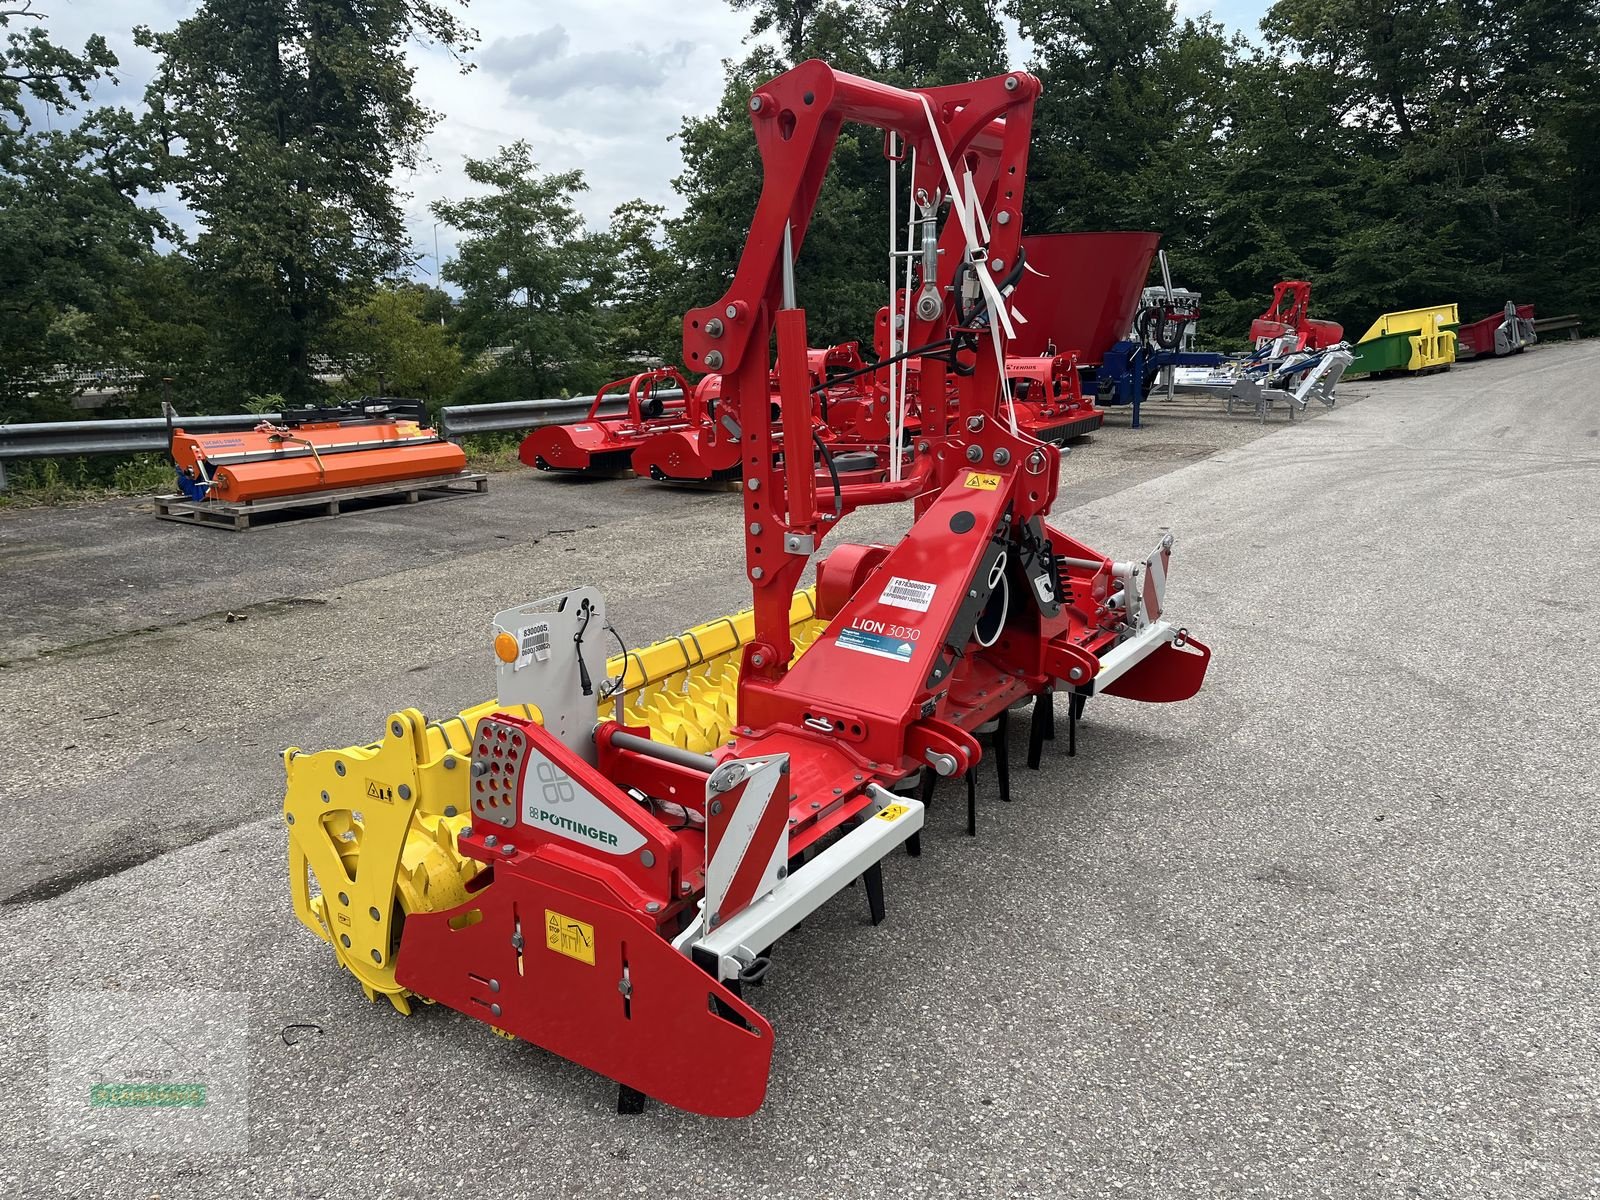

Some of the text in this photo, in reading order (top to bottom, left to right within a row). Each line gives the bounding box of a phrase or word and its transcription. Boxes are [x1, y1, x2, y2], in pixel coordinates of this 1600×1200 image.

[851, 617, 885, 634] LION
[886, 624, 921, 641] 3030
[540, 810, 618, 847] PÖTTINGER
